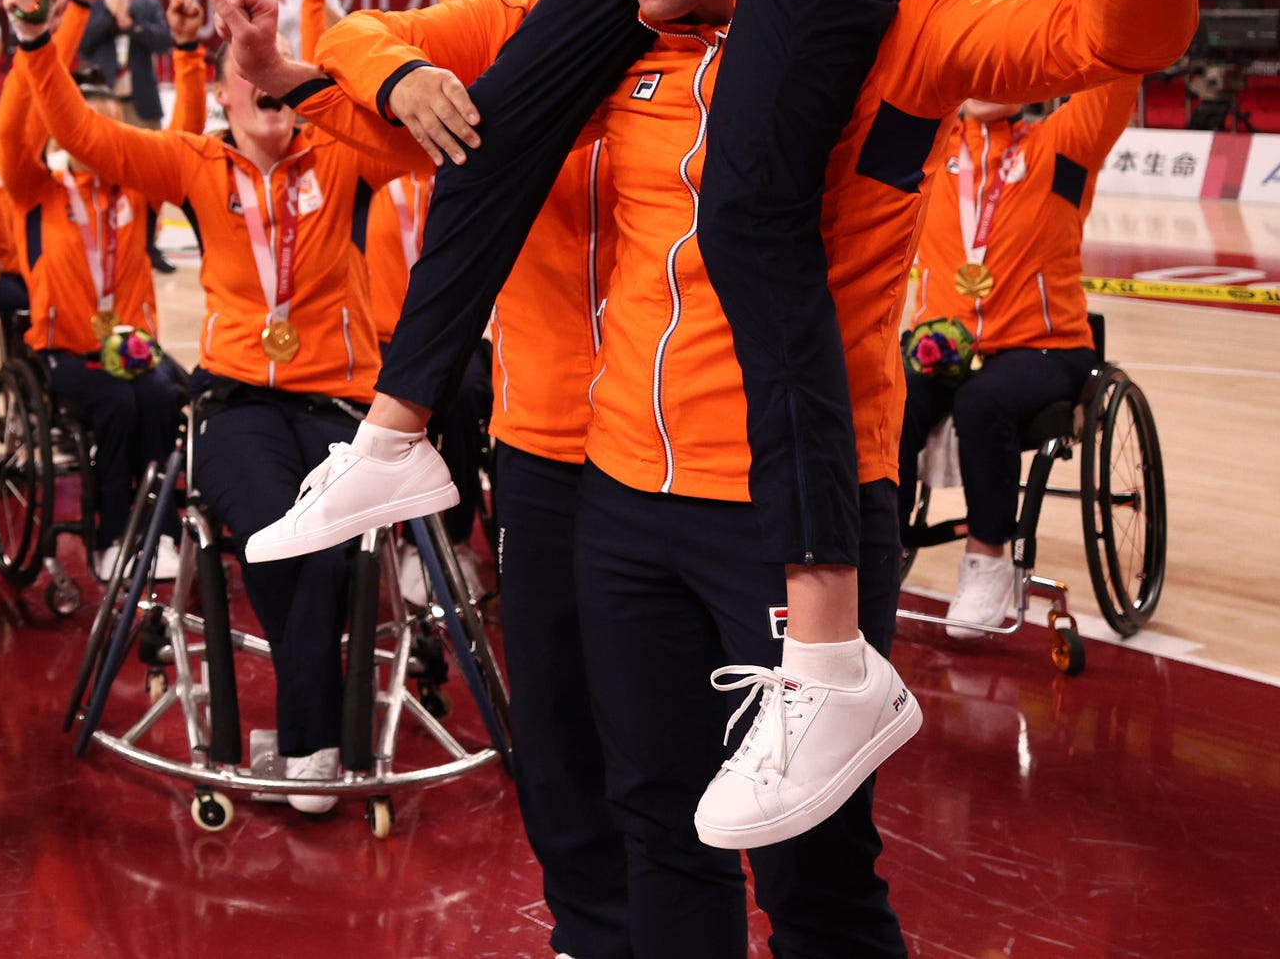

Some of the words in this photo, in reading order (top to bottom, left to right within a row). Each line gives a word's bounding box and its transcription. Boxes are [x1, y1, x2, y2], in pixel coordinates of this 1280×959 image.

[1101, 150, 1198, 178] 本生命
[892, 688, 908, 712] FILA
